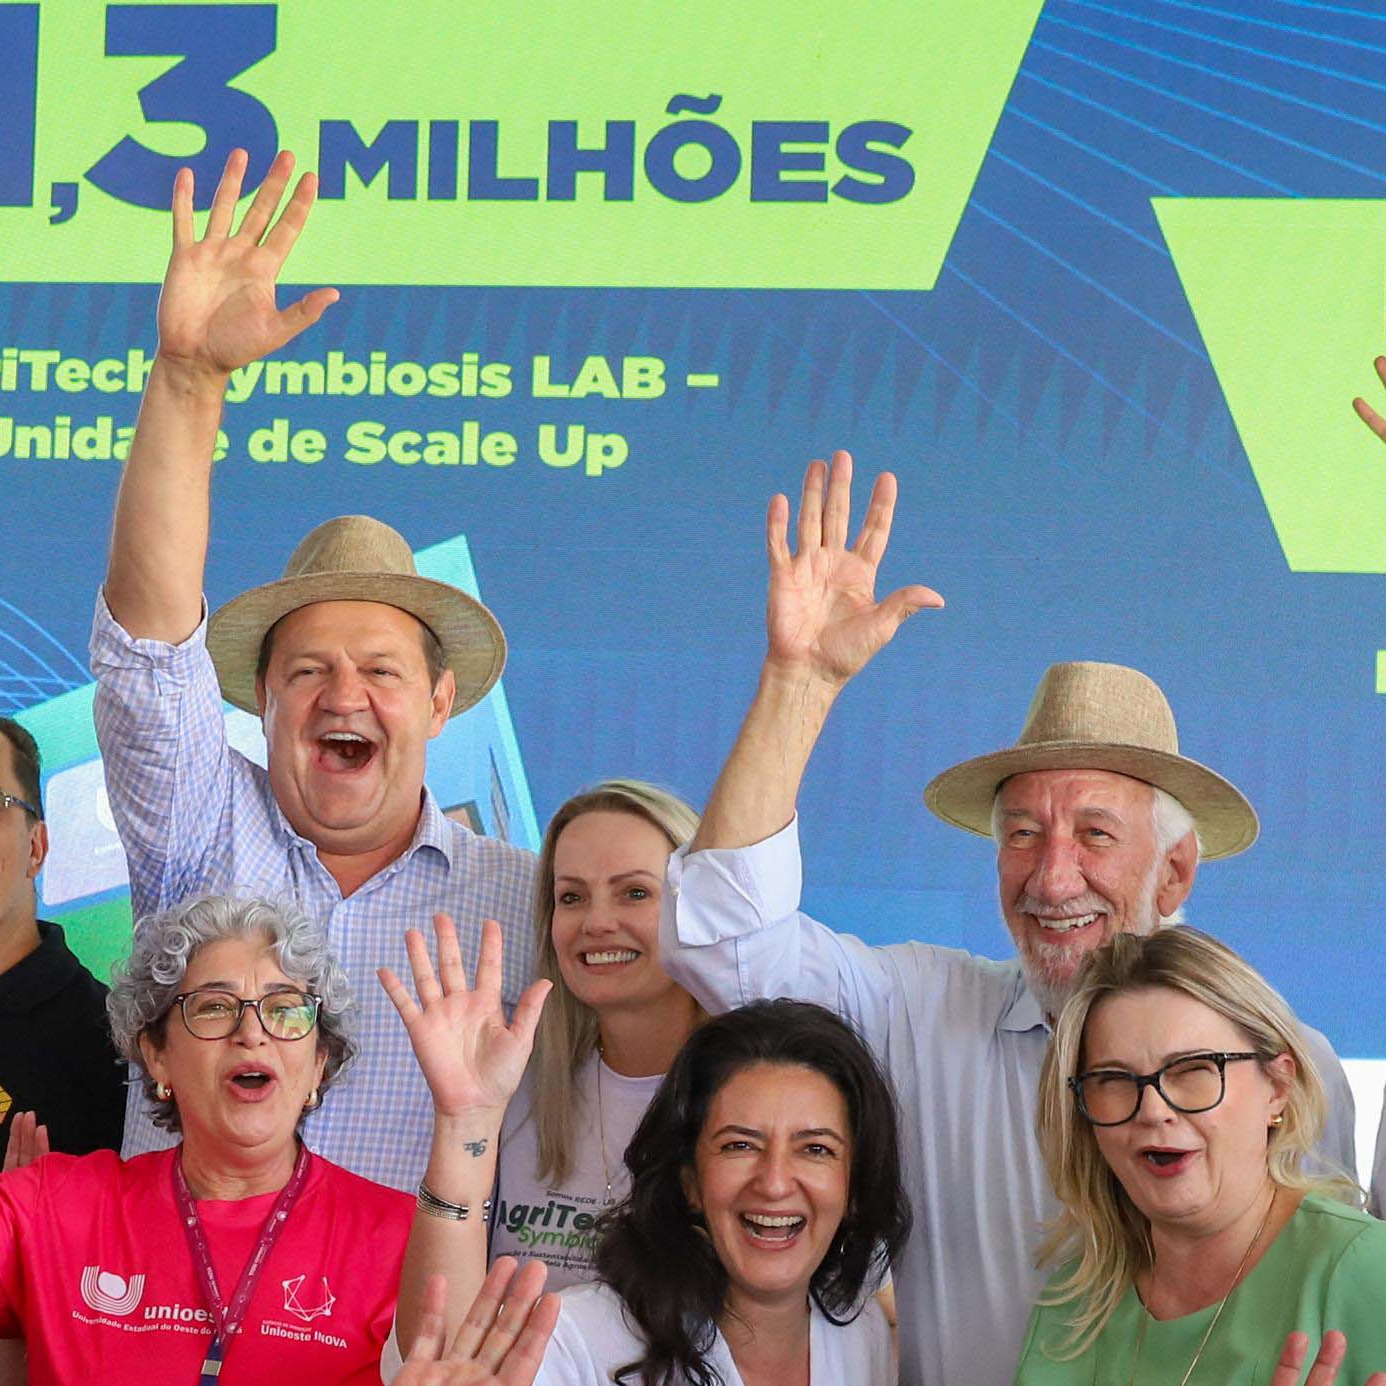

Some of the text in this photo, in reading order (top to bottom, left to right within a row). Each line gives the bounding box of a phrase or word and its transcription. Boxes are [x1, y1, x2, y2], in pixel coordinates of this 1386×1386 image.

[318, 94, 916, 205] MILHÕES
[223, 351, 513, 403] ymbiosis
[531, 355, 666, 400] LAB
[248, 418, 327, 464] de
[344, 419, 518, 466] Scale
[538, 423, 630, 477] Up
[72, 1310, 122, 1328] Universidade
[123, 1323, 159, 1333] Estadual
[173, 1323, 199, 1335] Oeste
[200, 1326, 212, 1335] do
[260, 1324, 311, 1342] Unioeste
[313, 1331, 348, 1349] INOVA
